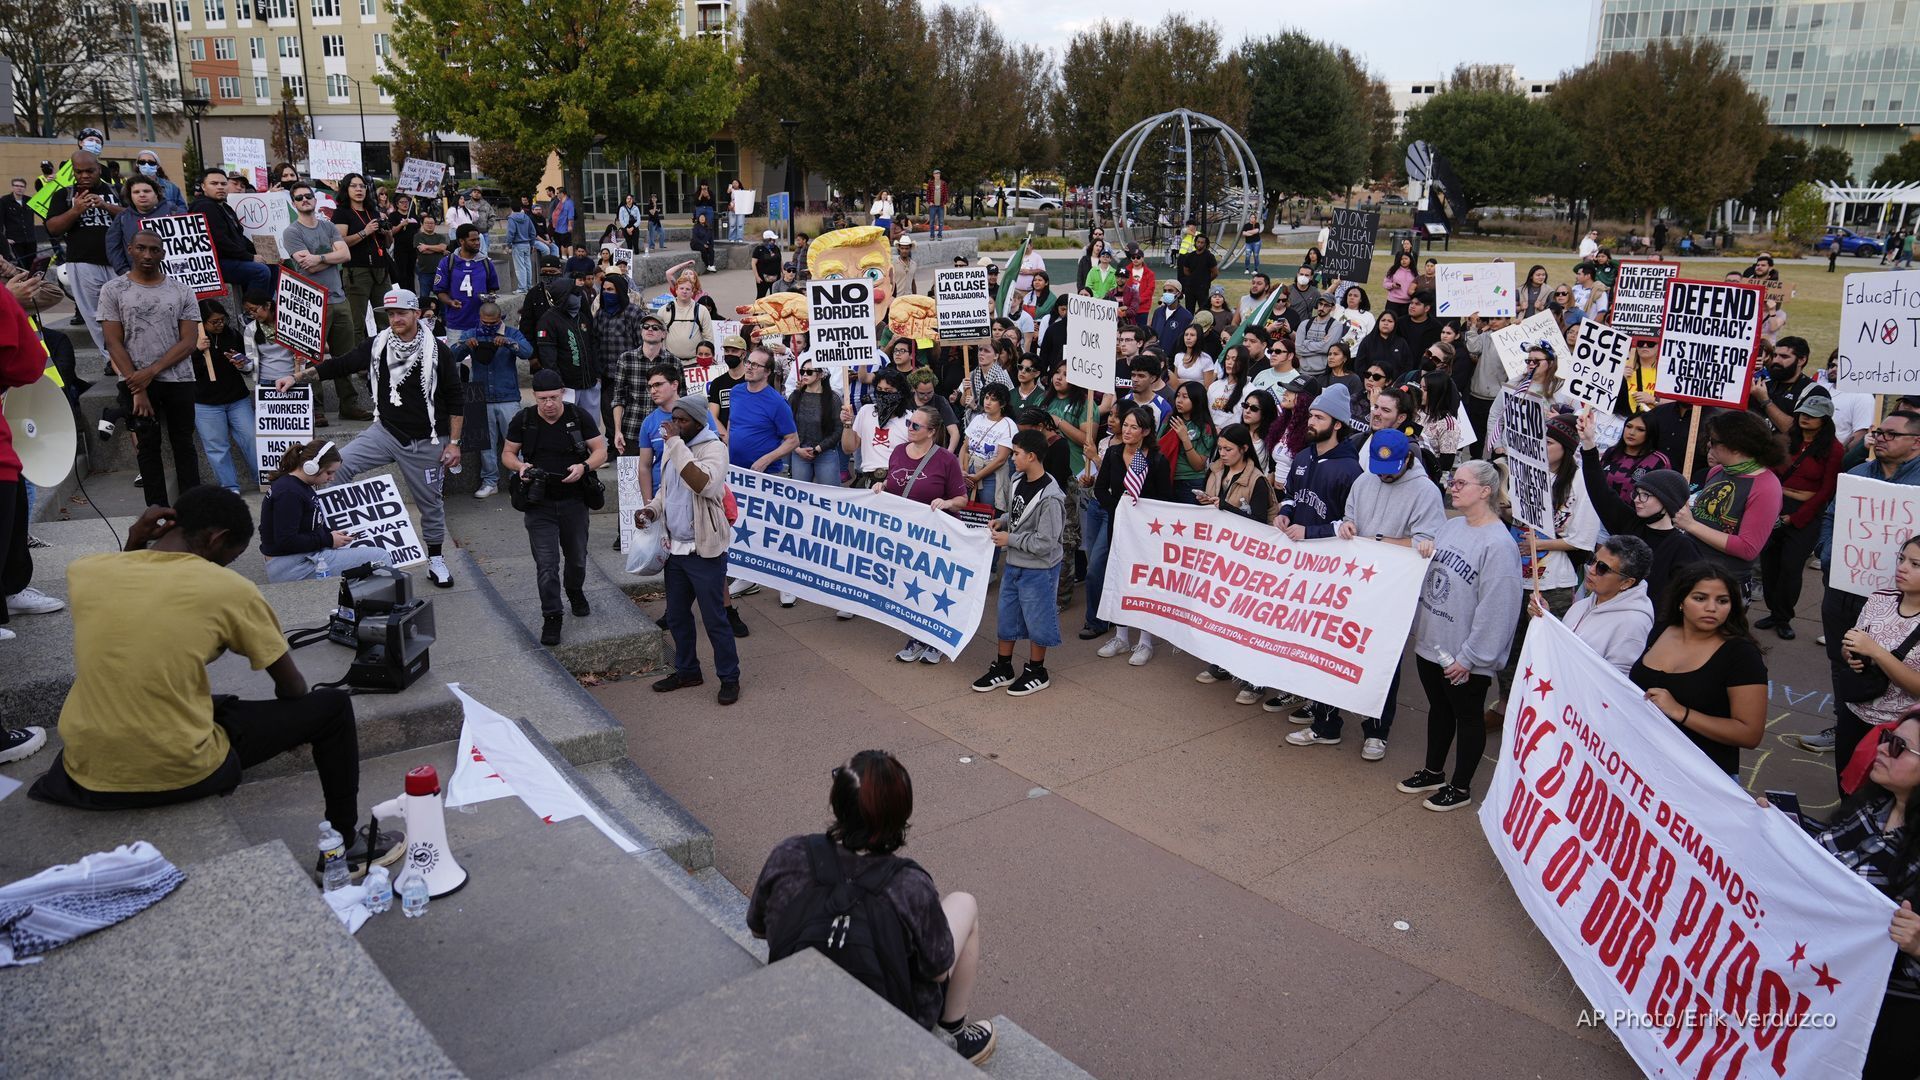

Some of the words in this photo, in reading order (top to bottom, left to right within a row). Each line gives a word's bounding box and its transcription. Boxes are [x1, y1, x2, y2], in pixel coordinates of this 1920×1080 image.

[244, 202, 263, 223] NO
[1332, 210, 1347, 226] NO
[1349, 212, 1370, 229] ONE
[142, 218, 176, 237] END
[174, 214, 207, 236] THE
[1329, 227, 1337, 237] IS
[1340, 228, 1372, 244] ILLEGAL
[161, 234, 212, 256] TACKS
[1327, 239, 1340, 252] ON
[1340, 242, 1374, 259] STOLEN
[188, 255, 216, 272] OUR
[1621, 267, 1638, 275] THE
[1640, 268, 1676, 277] PEOPLE
[460, 274, 473, 297] 4
[938, 272, 964, 281] ¡PODER
[965, 271, 985, 279] PARA
[939, 281, 951, 292] LA
[954, 280, 986, 291] CLASE
[281, 279, 323, 307] ¡DINERO
[290, 294, 305, 305] PARA
[305, 300, 312, 309] EL
[812, 283, 869, 305] NO
[939, 292, 987, 300] TRABAJADORA,
[1639, 290, 1665, 299] DEFEN
[1670, 283, 1757, 320] DEFEND
[1765, 294, 1784, 302] IANCE
[1846, 279, 1920, 308] Educatio
[279, 295, 322, 328] PUEBLO,
[813, 304, 870, 320] BORDER
[952, 310, 971, 319] PARA
[973, 309, 987, 318] LOS
[1068, 297, 1118, 322] COMPASSION
[1613, 312, 1663, 324] FAMILIES
[1615, 303, 1664, 313] IMMIGRAN
[277, 321, 286, 334] LA
[288, 328, 320, 350] GUERRA!
[279, 310, 292, 325] NO
[295, 318, 320, 341] PARA
[817, 326, 868, 342] PATROL
[1666, 314, 1752, 341] DEMOCRACY:
[1081, 330, 1100, 349] OVER
[1580, 321, 1628, 357] ICE
[815, 346, 873, 362] CHARLOTTE!
[1577, 343, 1621, 373] OUT
[1662, 339, 1686, 359] IT'S
[1689, 342, 1720, 363] TIME
[1720, 346, 1749, 367] FOR
[684, 367, 710, 383] FEAT
[1071, 356, 1103, 379] CAGES
[1573, 362, 1591, 376] OF
[1591, 371, 1615, 392] OUR
[1667, 357, 1676, 375] A
[1678, 359, 1735, 383] GENERAL
[1116, 377, 1132, 387] Bern
[1674, 376, 1725, 399] STRIKE!
[264, 391, 303, 399] SOLIDARITY!
[1569, 379, 1618, 411] CITY
[268, 403, 309, 414] WORKERS'
[1504, 391, 1544, 440] DEFEND
[259, 417, 310, 430] STRUGGLE
[1351, 419, 1370, 432] XICO
[268, 441, 286, 453] HAS
[1506, 429, 1546, 463] DEMOCRACY:
[1509, 455, 1520, 479] IT'S
[1520, 463, 1534, 487] TIME
[1533, 468, 1549, 493] FOR
[317, 480, 394, 515] TRUMP:
[1514, 477, 1519, 498] A
[1520, 480, 1546, 511] GENERAL
[326, 501, 402, 531] END
[761, 478, 831, 511] PEOPLE
[837, 501, 903, 533] UNITED
[907, 522, 952, 551] WILL
[1520, 498, 1544, 530] STRIKE!
[1850, 495, 1915, 525] THIS
[368, 520, 408, 536] WAR
[1848, 518, 1877, 540] IS
[732, 491, 804, 530] FEND
[811, 515, 974, 591] IMMIGRANT
[1194, 522, 1213, 542] EL
[1215, 528, 1292, 565] PUEBLO
[1293, 552, 1341, 574] UNIDO
[391, 545, 421, 564] ANTS
[762, 527, 897, 589] FAMILIES!
[1844, 544, 1888, 571] OUR
[1163, 542, 1290, 600] DEFENDERÁ
[1289, 580, 1308, 604] A
[1308, 582, 1352, 610] LAS
[1850, 568, 1897, 589] PEOPL
[729, 552, 742, 561] OR
[745, 556, 793, 576] SOCIALISM
[795, 572, 813, 582] AND
[816, 578, 869, 600] LIBERATION
[884, 602, 953, 639] @PSLCHARLOTTE
[1130, 563, 1231, 609] FAMILIAS
[1228, 592, 1373, 655] MIGRANTES!
[1126, 598, 1156, 609] PARTY
[1157, 604, 1171, 613] FOR
[1190, 614, 1203, 625] AND
[1204, 621, 1243, 641] LIBERATION
[1249, 636, 1289, 655] CHARLOTTE
[1290, 648, 1356, 679] @PSLNATIONAL
[1562, 704, 1655, 813] CHARLOTTE
[1655, 802, 1765, 929] DEMANDS:
[422, 841, 433, 849] NO
[1503, 778, 1561, 866] OUT
[1542, 836, 1596, 907] OF
[1580, 878, 1657, 995] OUR
[1565, 761, 1676, 923] BORDER
[1669, 876, 1811, 1078] PATROL
